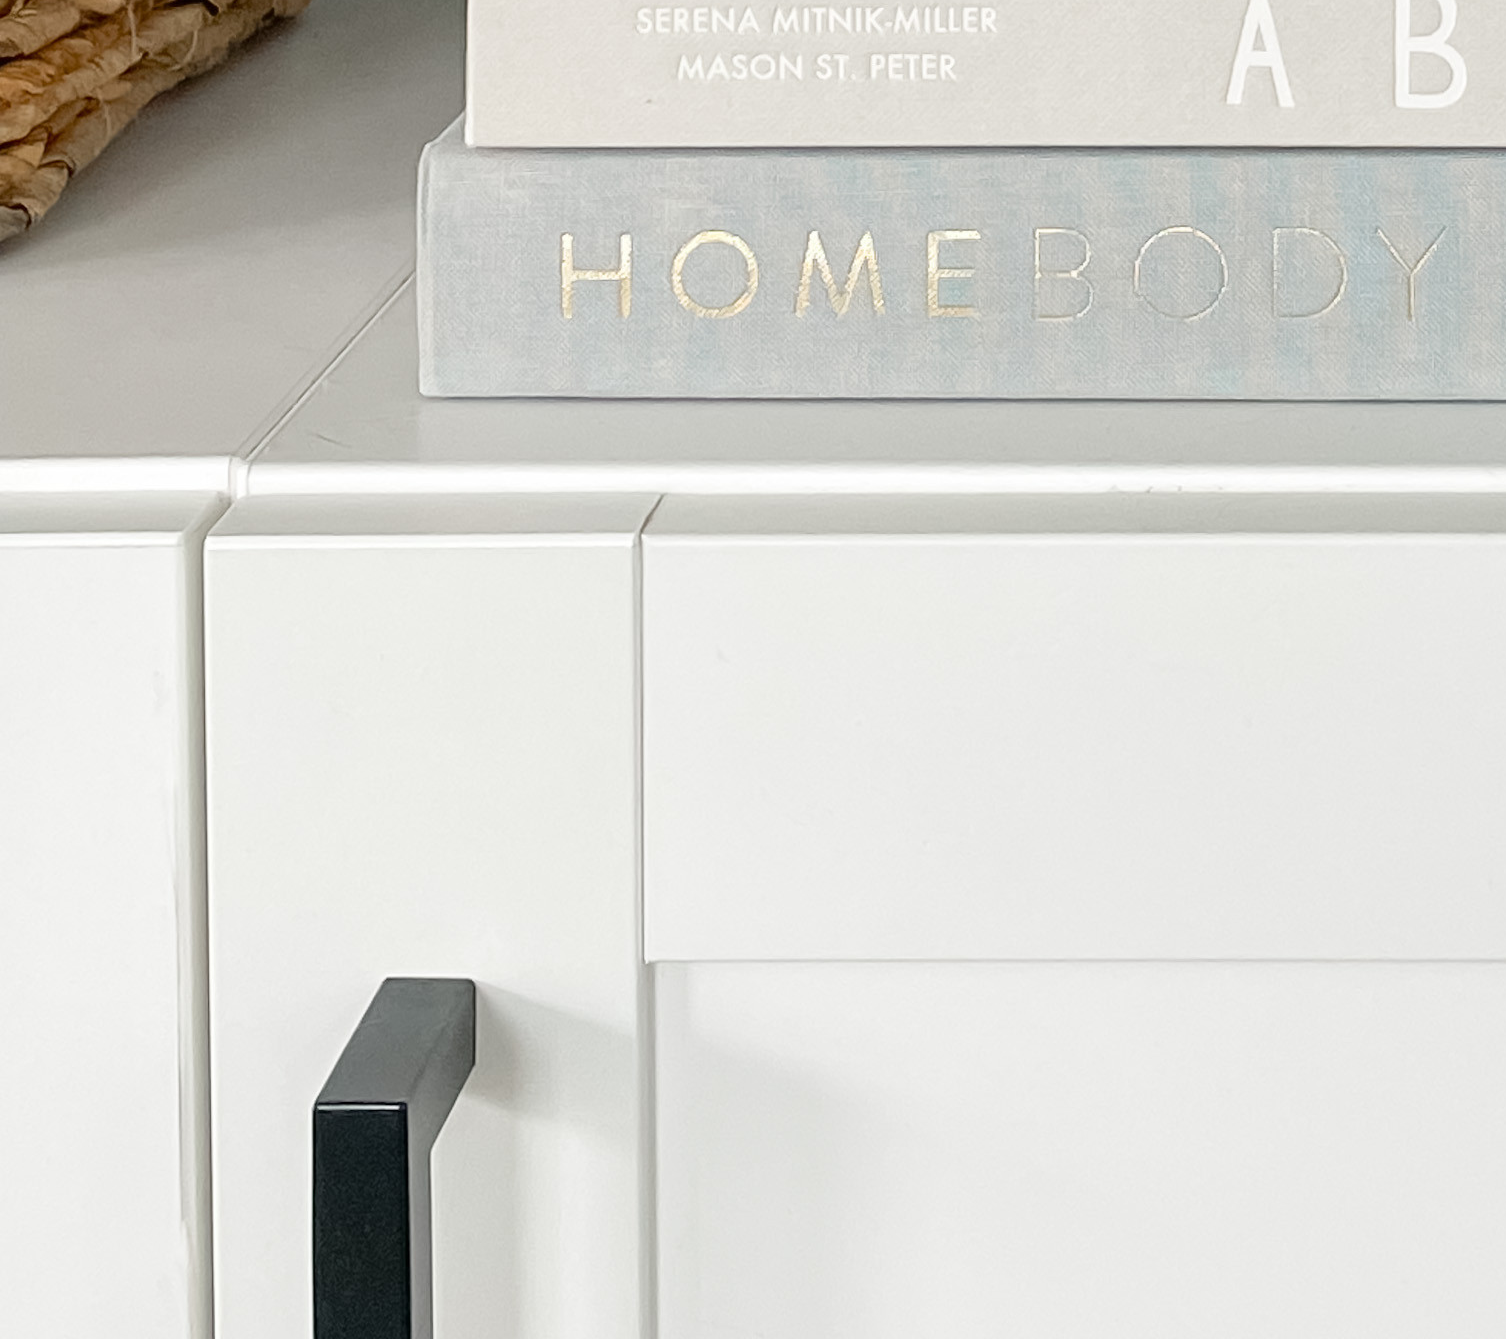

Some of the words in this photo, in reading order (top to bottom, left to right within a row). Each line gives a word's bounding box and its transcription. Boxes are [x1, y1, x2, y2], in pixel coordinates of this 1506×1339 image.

[635, 6, 761, 35] SERENA
[771, 5, 999, 35] MITNIK-MILLER
[676, 53, 803, 82] MASON
[814, 53, 858, 82] ST.
[869, 53, 958, 82] PETER
